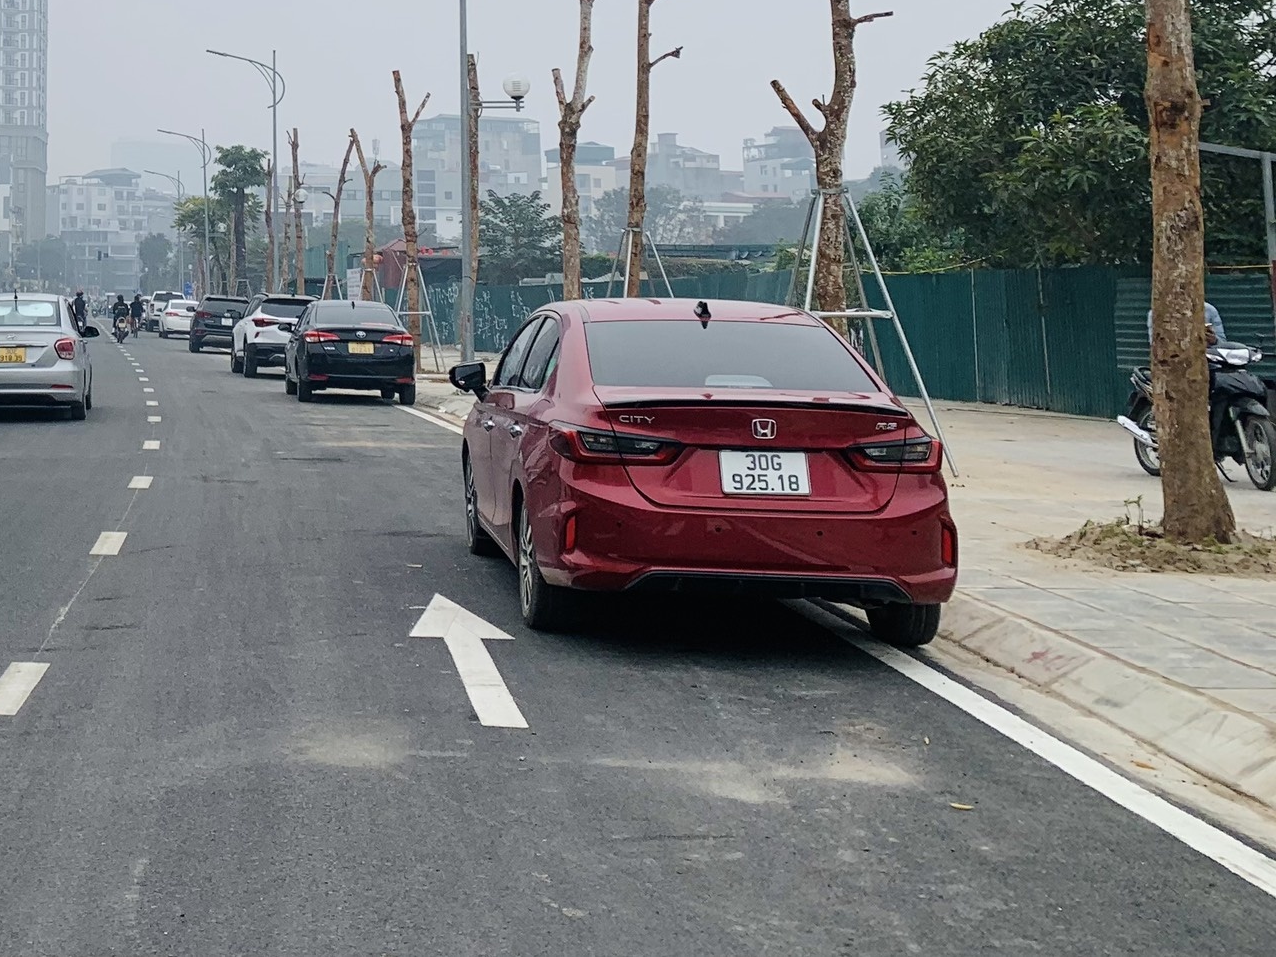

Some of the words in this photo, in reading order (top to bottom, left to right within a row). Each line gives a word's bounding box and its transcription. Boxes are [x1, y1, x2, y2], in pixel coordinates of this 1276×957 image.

[619, 415, 655, 424] CITY
[745, 454, 782, 471] 30G
[732, 473, 800, 492] 925.18
